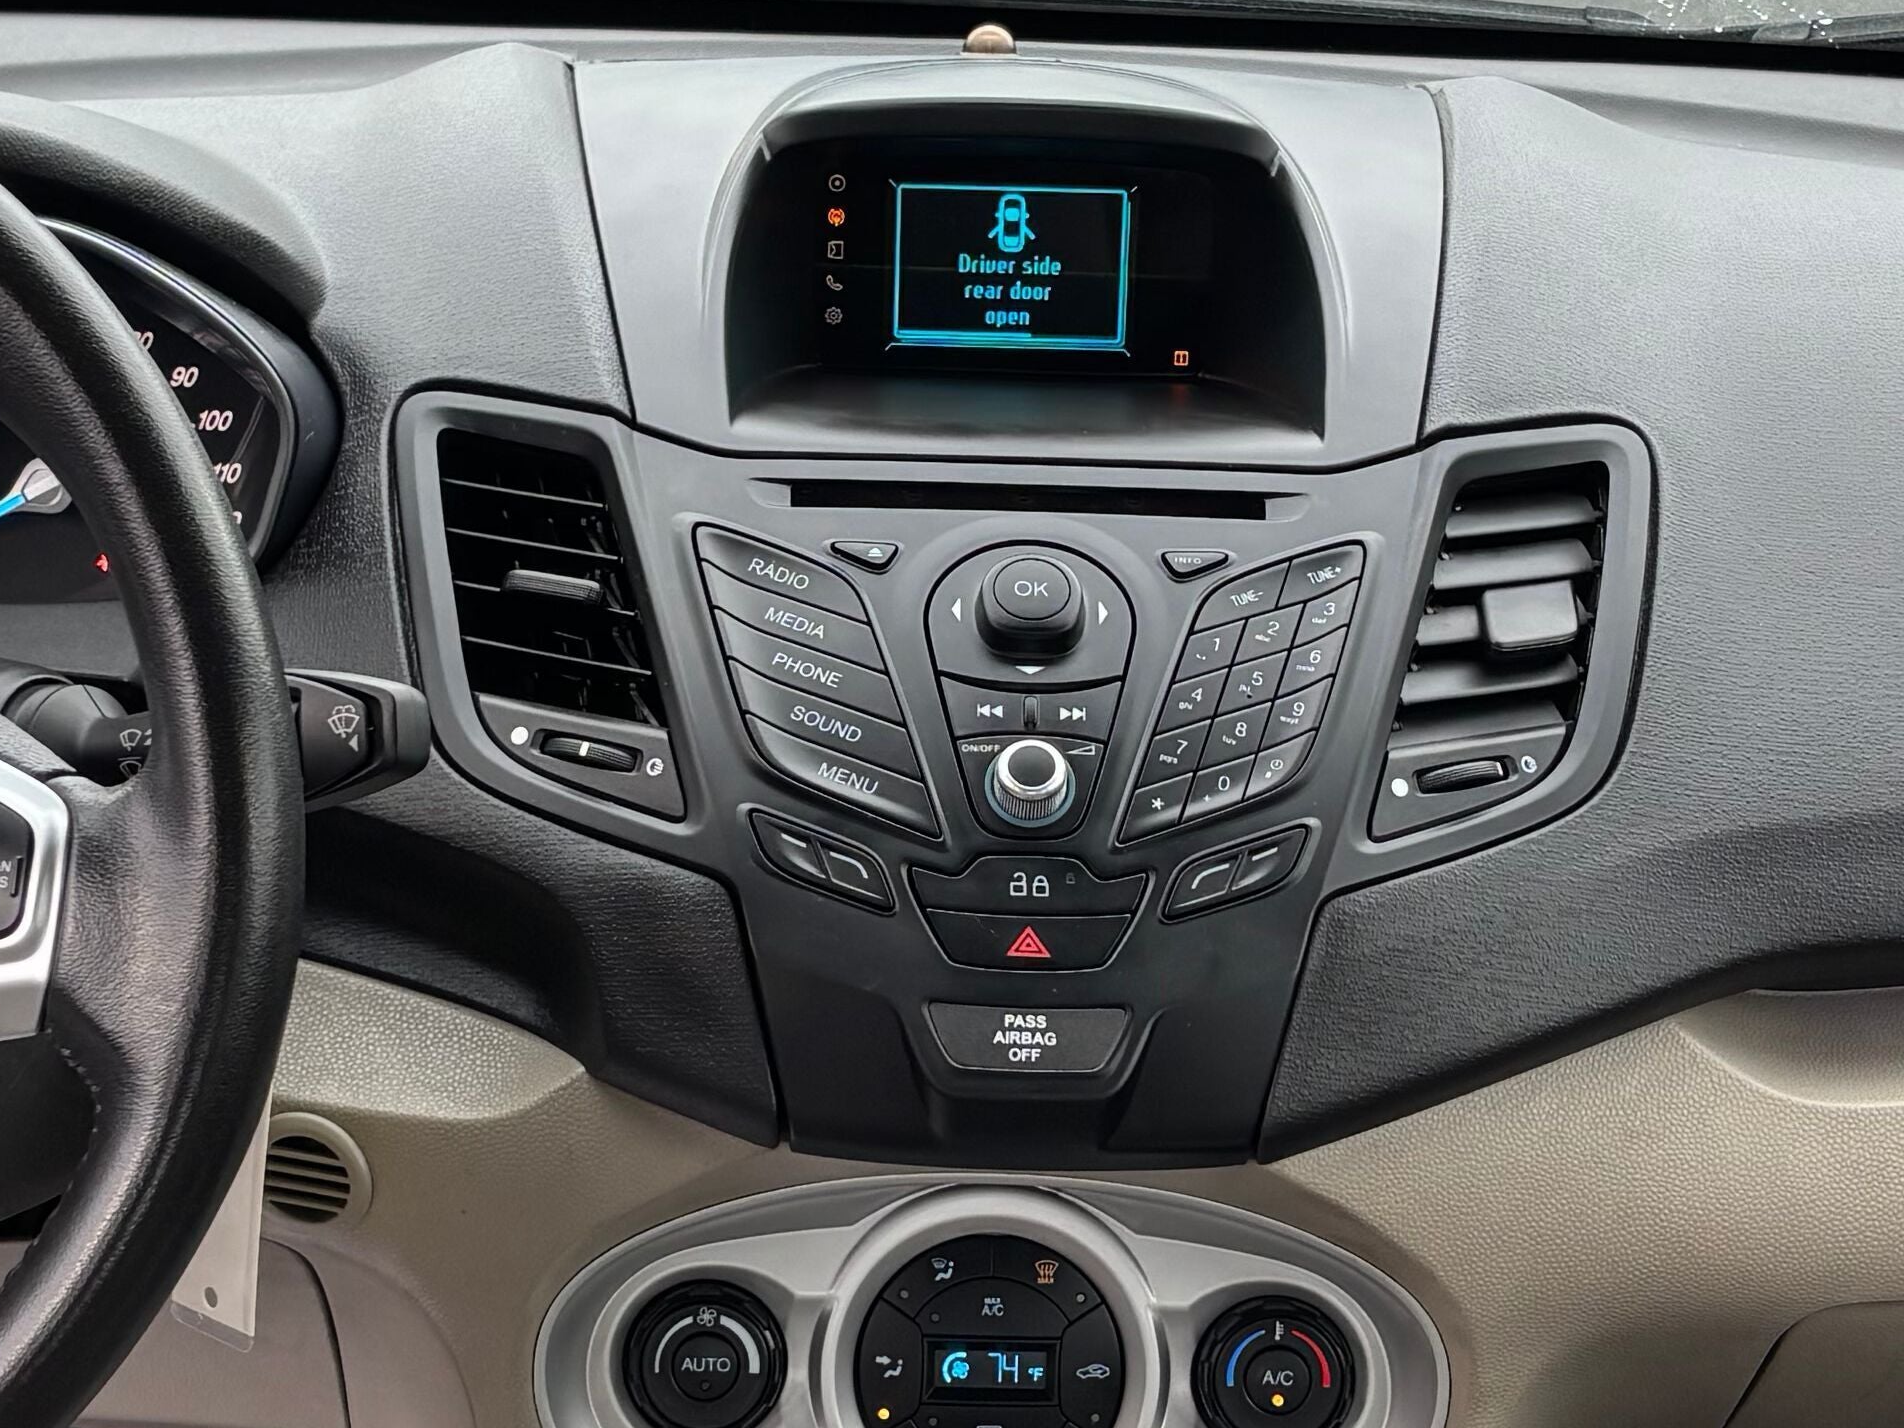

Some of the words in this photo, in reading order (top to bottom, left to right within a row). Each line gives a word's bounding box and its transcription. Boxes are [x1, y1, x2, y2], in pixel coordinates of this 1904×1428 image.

[958, 253, 1016, 274] Driver
[1022, 255, 1062, 275] side
[964, 284, 1004, 300] rear
[1009, 280, 1052, 301] door
[985, 310, 1030, 328] open
[170, 366, 199, 388] 90
[198, 409, 234, 432] 100
[1174, 556, 1202, 565] INFO
[747, 557, 810, 590] RADIO
[1014, 580, 1049, 597] OK
[1323, 602, 1335, 616] 3
[764, 606, 826, 639] MEDIA
[1267, 621, 1280, 636] 2
[1212, 637, 1220, 652] 1
[1309, 649, 1322, 664] 6
[771, 652, 844, 689] PHONE
[1251, 671, 1264, 686] 5
[1191, 687, 1203, 702] 4
[1292, 701, 1305, 717] 9
[790, 705, 862, 743] SOUND
[1235, 722, 1247, 737] 8
[961, 744, 1001, 754] ON/OFF
[1176, 739, 1188, 755] 7
[817, 762, 879, 795] MENU
[1218, 775, 1231, 791] 0
[1004, 1014, 1047, 1029] PASS
[993, 1030, 1057, 1046] AIRBAG
[1008, 1047, 1042, 1062] OFF
[981, 1304, 1004, 1317] A/C
[681, 1357, 731, 1372] AUTO
[987, 1352, 1019, 1383] 74
[1262, 1369, 1294, 1386] A/C
